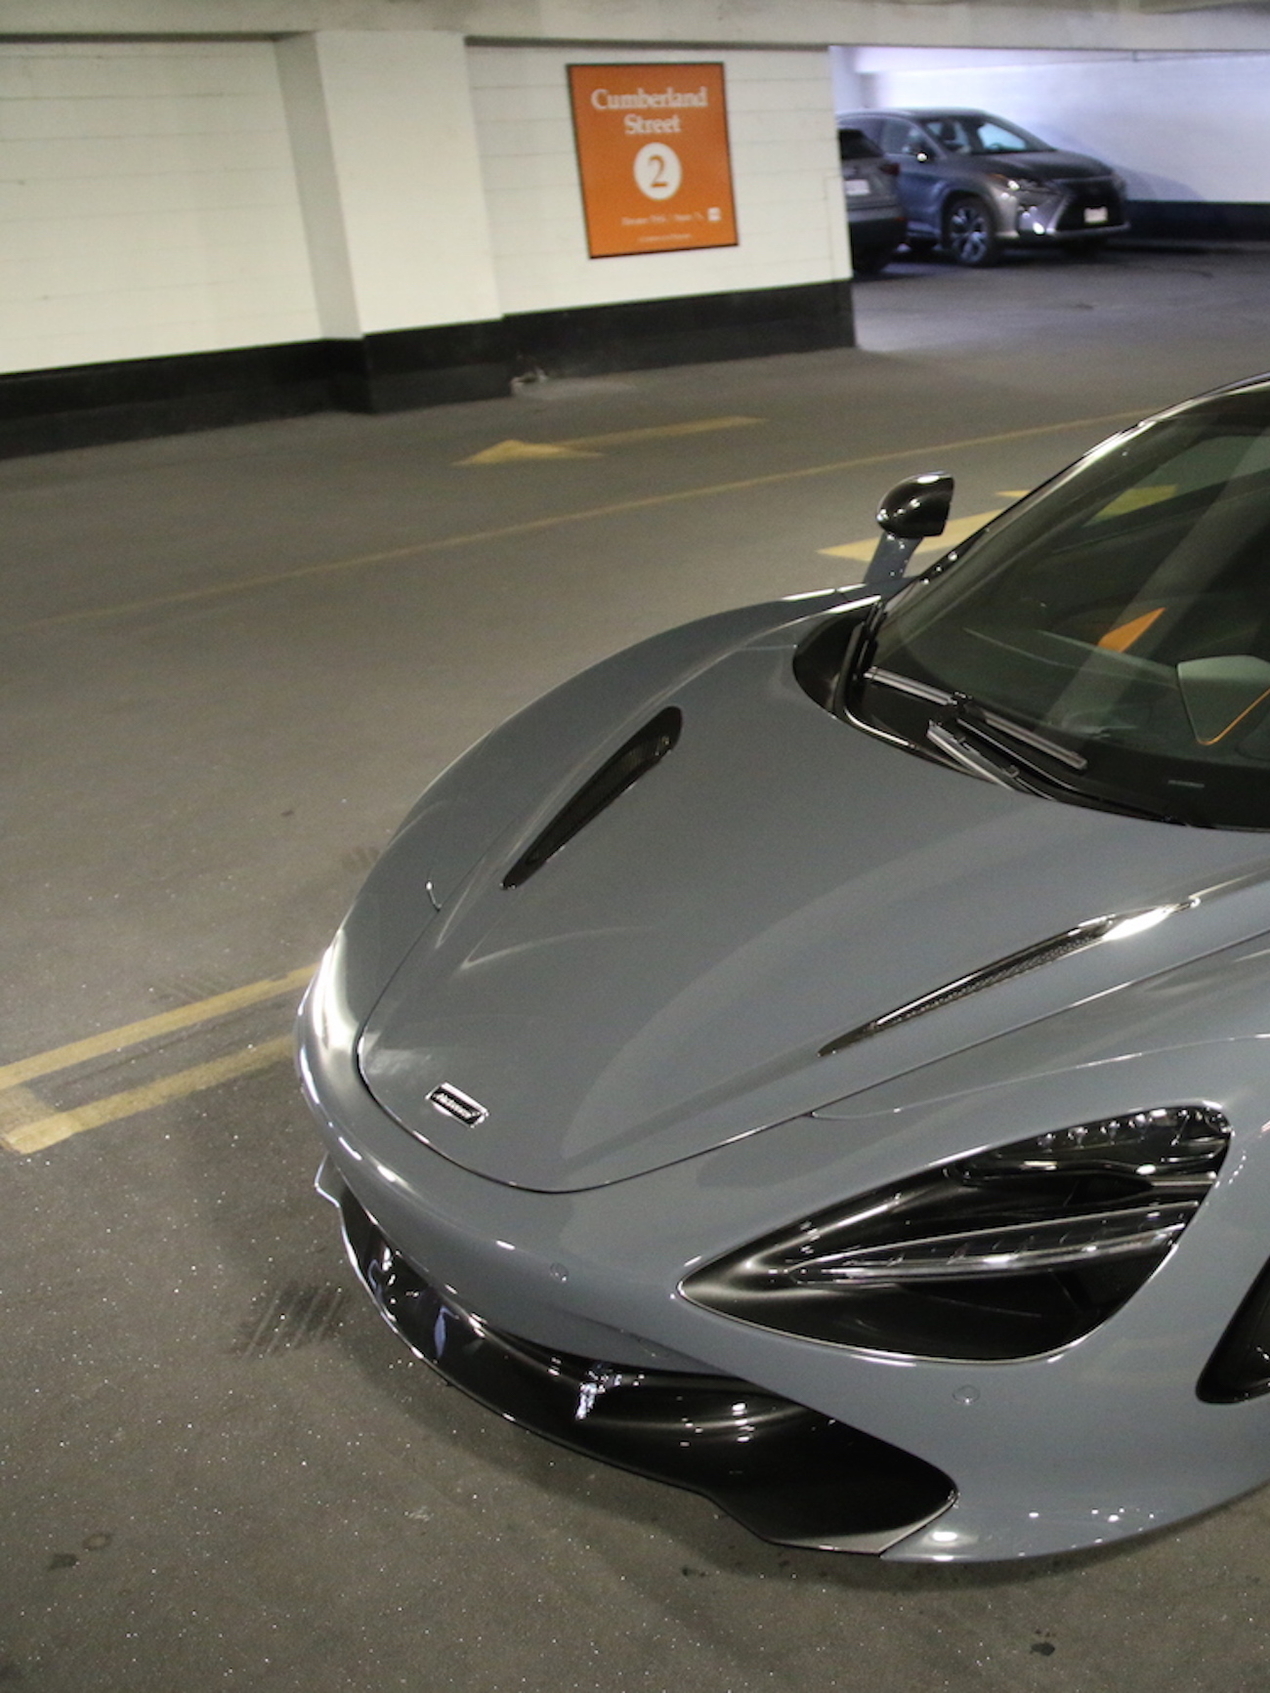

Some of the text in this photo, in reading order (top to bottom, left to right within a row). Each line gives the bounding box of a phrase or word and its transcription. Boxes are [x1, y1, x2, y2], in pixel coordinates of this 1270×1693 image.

[590, 86, 708, 110] Cumberland
[623, 113, 681, 135] Street
[648, 155, 668, 187] 2
